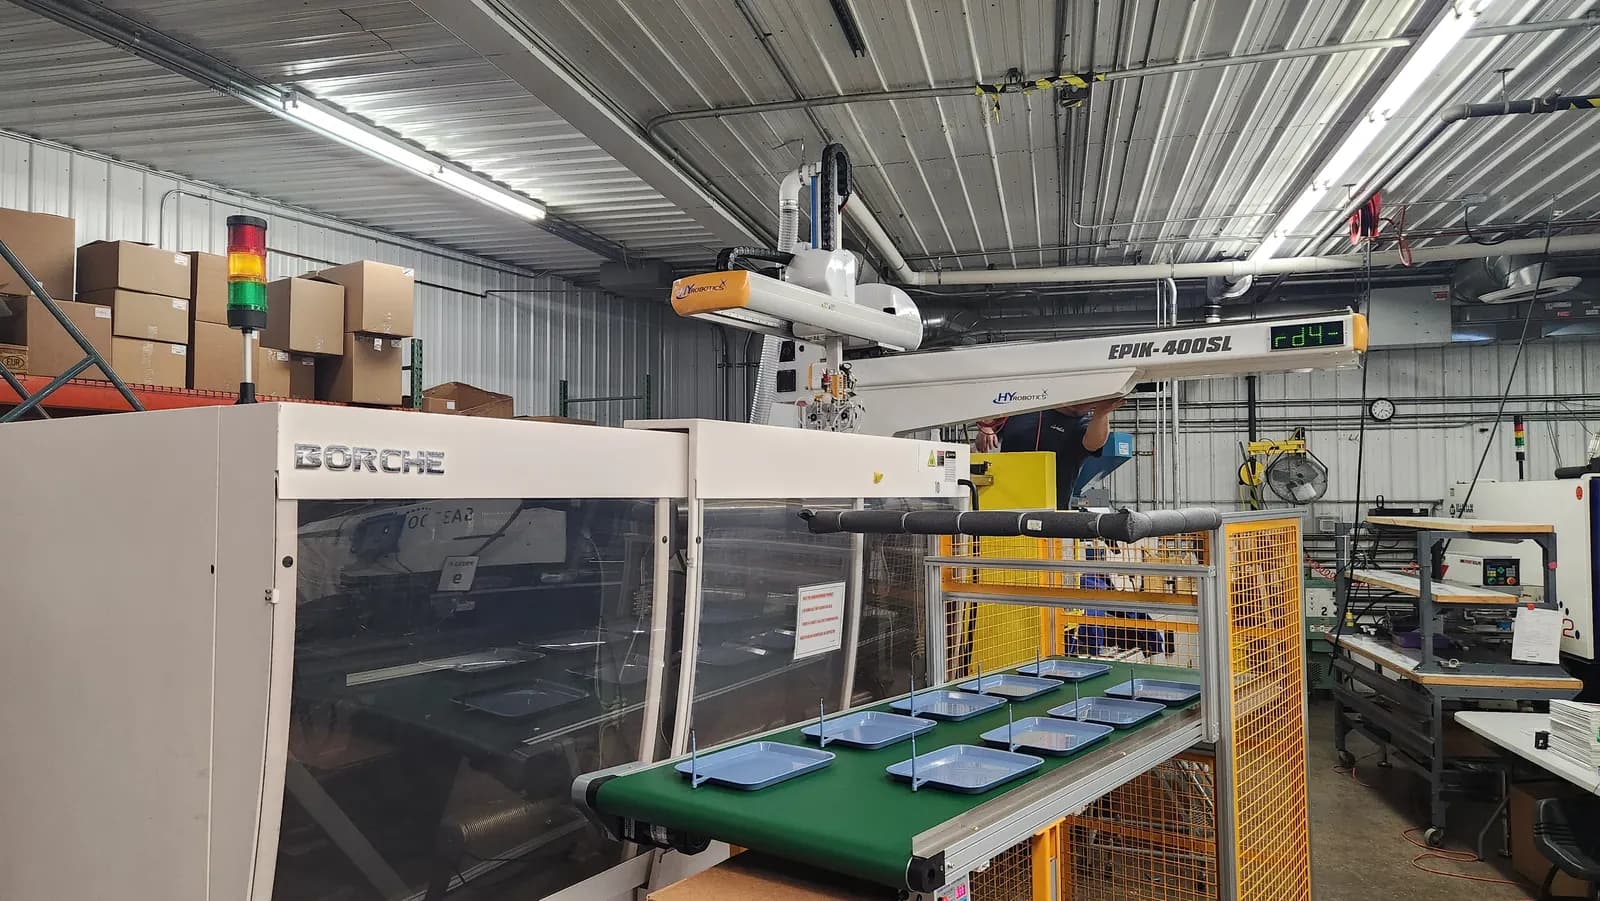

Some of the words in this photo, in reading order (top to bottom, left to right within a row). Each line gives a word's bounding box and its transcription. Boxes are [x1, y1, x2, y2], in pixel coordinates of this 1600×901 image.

[1108, 336, 1232, 360] EPIK-400SL
[6, 358, 20, 367] EUR
[294, 443, 445, 475] BORCHE
[1321, 606, 1328, 616] 2
